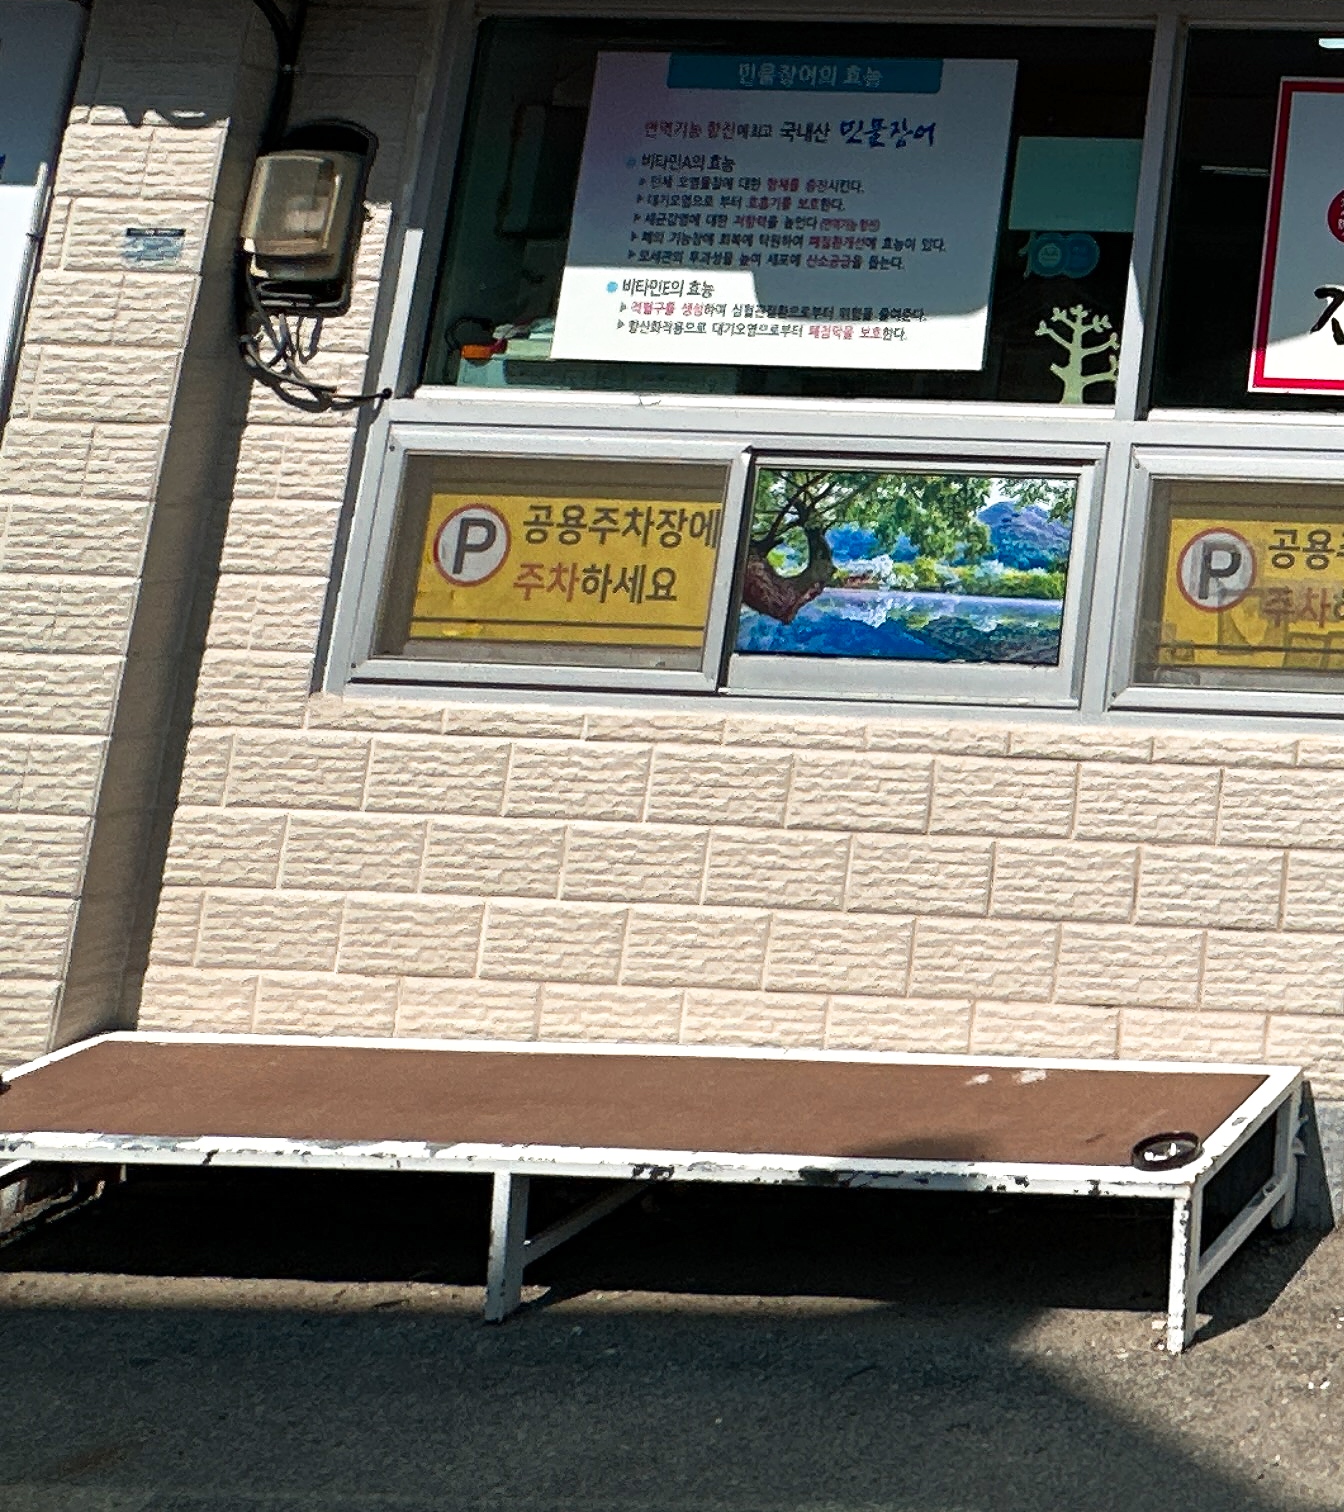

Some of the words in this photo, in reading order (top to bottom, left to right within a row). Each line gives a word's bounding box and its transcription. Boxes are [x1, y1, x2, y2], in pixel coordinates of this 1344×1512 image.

[780, 121, 831, 144] 국내산
[839, 117, 937, 149] 민물장어
[622, 278, 685, 298] 비타민E의
[686, 280, 715, 299] 효능
[452, 517, 497, 575] P
[522, 503, 721, 549] 공용주차장에
[513, 561, 678, 605] 주차하세요
[1198, 541, 1242, 600] P
